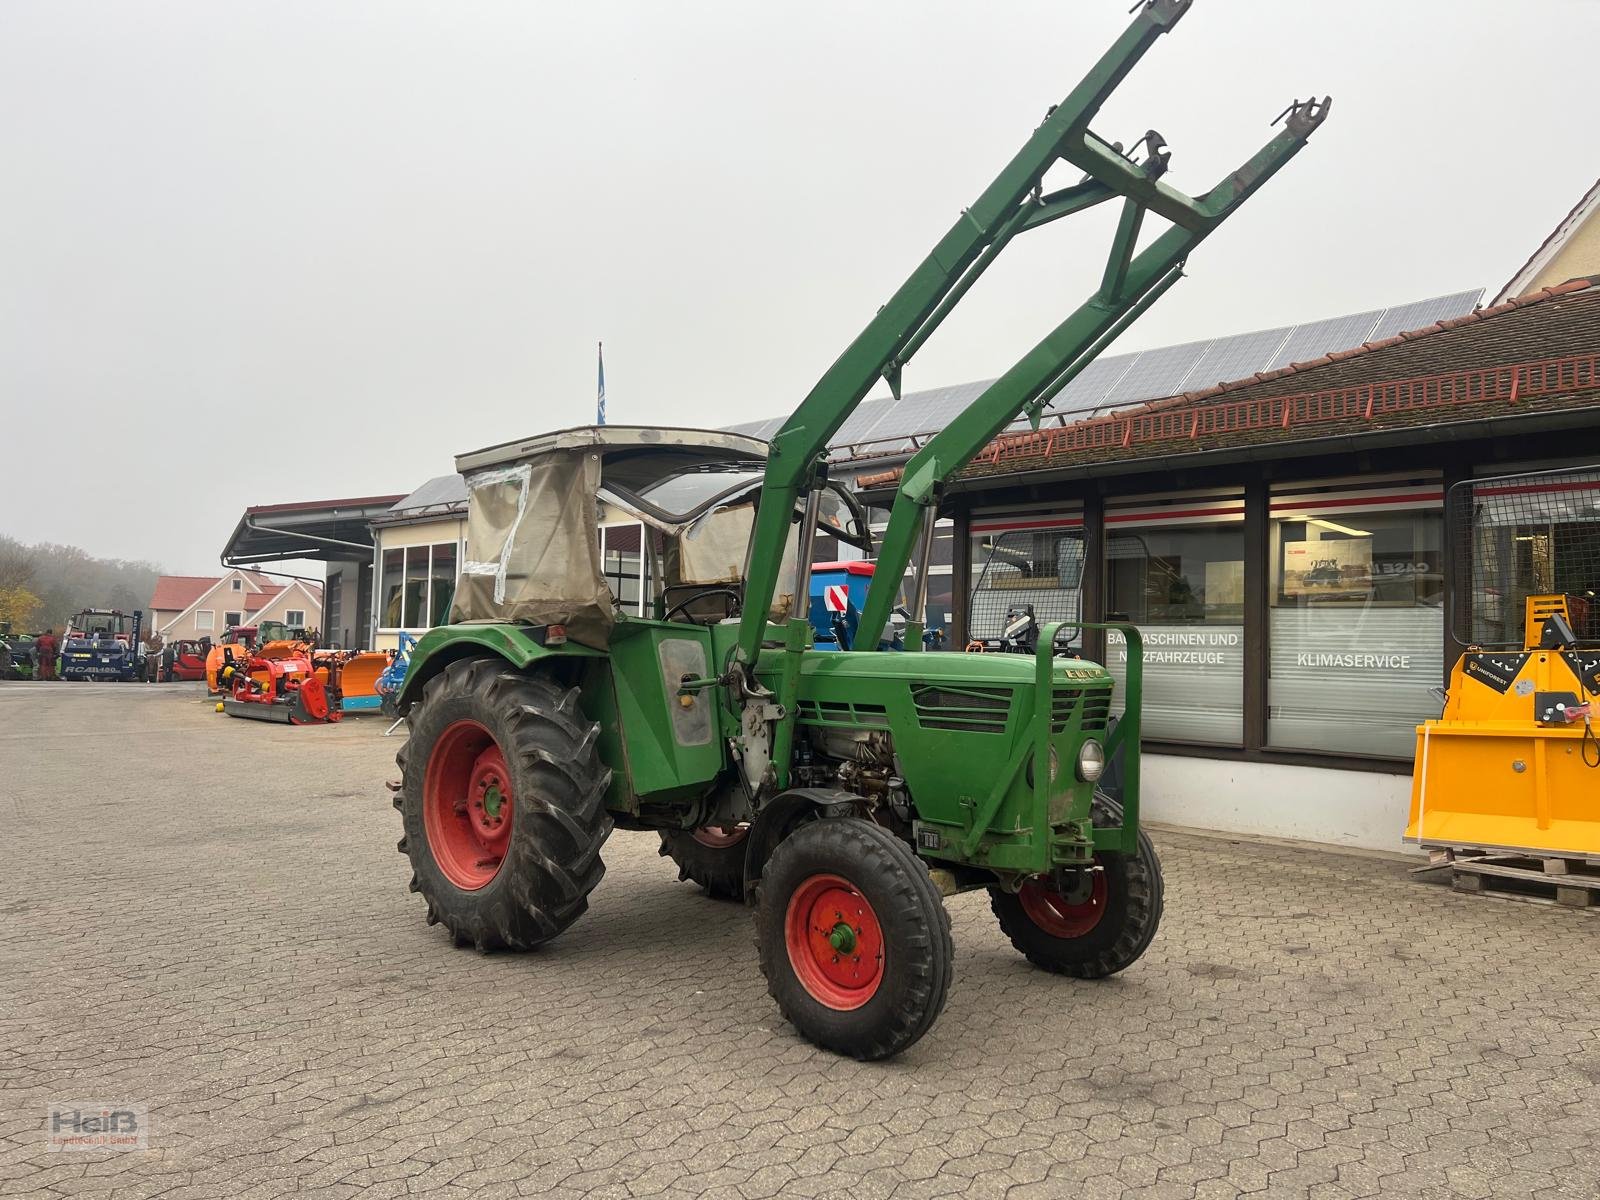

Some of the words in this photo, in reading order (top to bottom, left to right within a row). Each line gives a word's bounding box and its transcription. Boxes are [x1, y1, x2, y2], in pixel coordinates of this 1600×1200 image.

[1107, 633, 1205, 645] BAASCHINEN
[1209, 634, 1238, 646] UND
[1119, 651, 1225, 664] NZFAHRZEUGE
[1297, 653, 1411, 669] KLIMASERVICE
[1476, 666, 1508, 686] UNIFOREST
